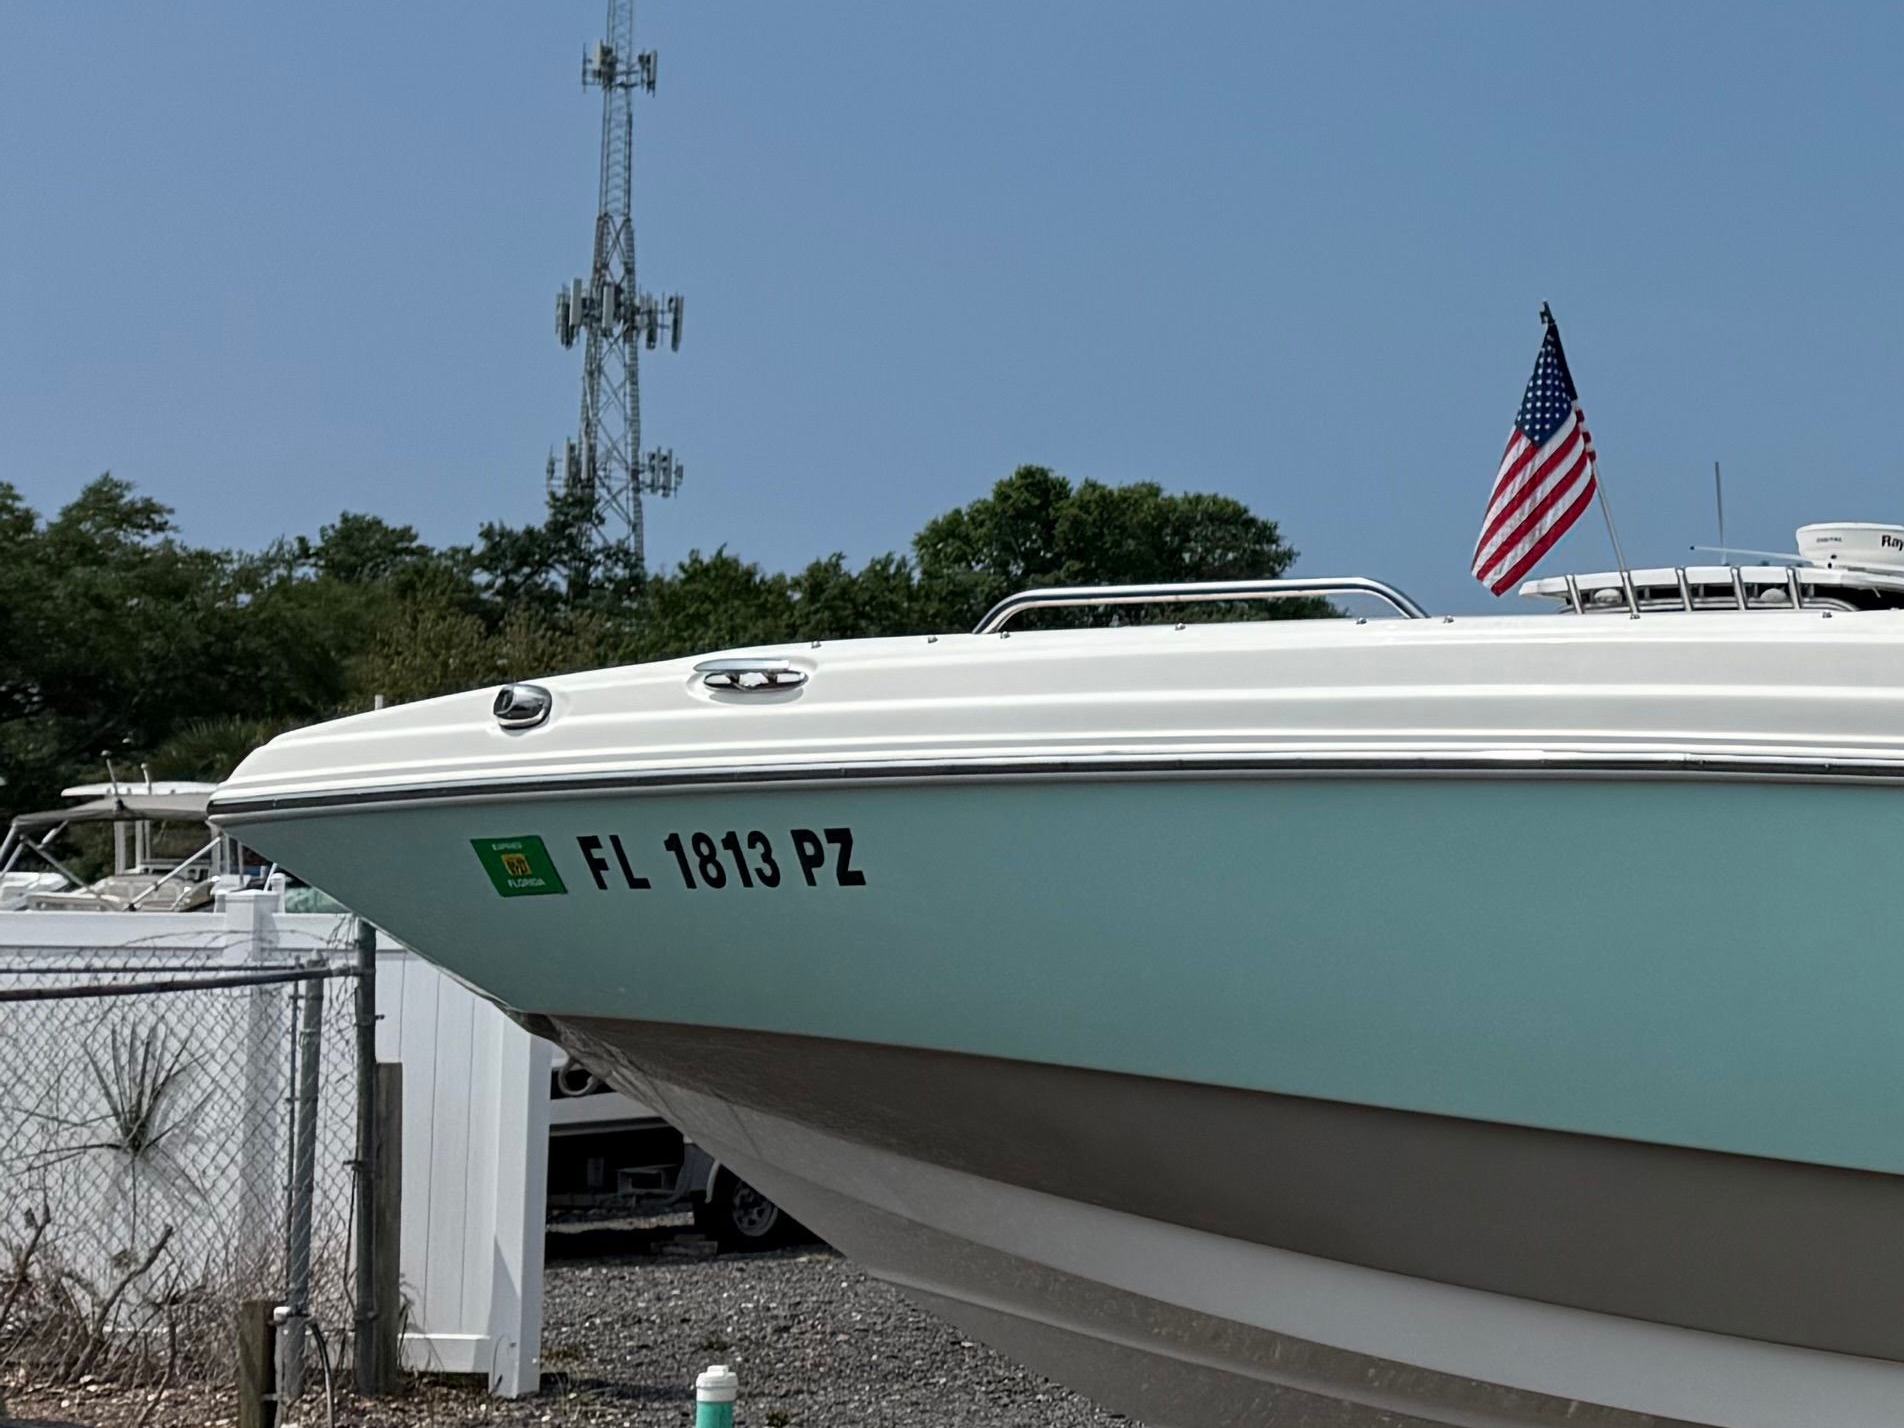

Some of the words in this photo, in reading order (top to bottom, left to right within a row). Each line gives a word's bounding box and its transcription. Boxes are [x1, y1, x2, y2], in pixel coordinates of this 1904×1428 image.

[576, 834, 651, 890] FL
[663, 830, 781, 889] 1813
[790, 827, 866, 887] PZ
[507, 877, 546, 888] FLORIDA
